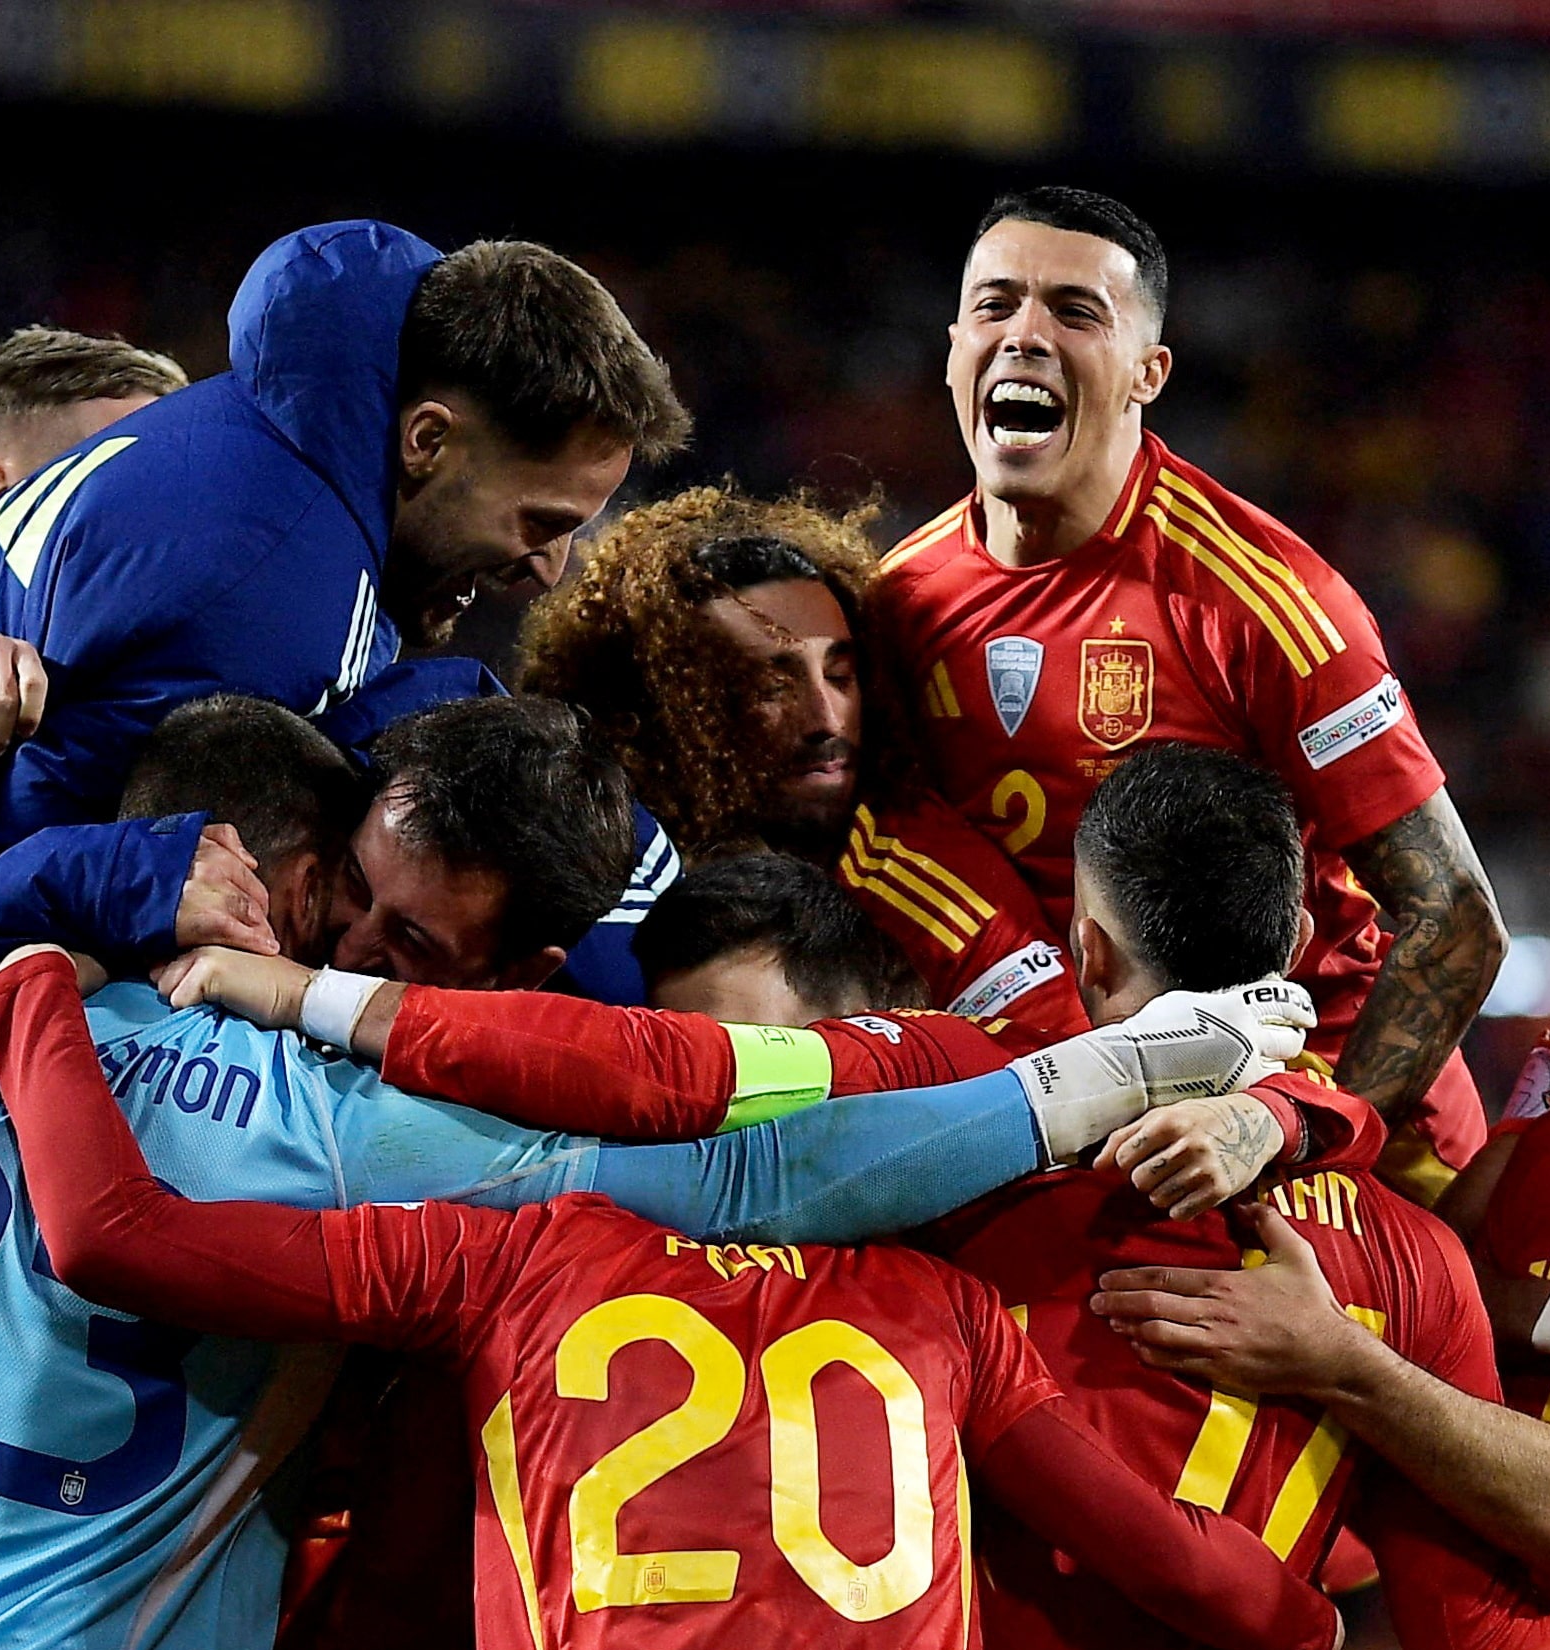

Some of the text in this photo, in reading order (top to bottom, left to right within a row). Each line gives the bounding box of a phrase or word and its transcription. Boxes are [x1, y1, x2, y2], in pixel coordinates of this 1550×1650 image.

[1306, 705, 1381, 754] FOUNDATION
[992, 769, 1046, 854] 2
[1030, 1057, 1054, 1094] SIMON
[1042, 1053, 1061, 1080] UNAI
[555, 1293, 935, 1623] 20
